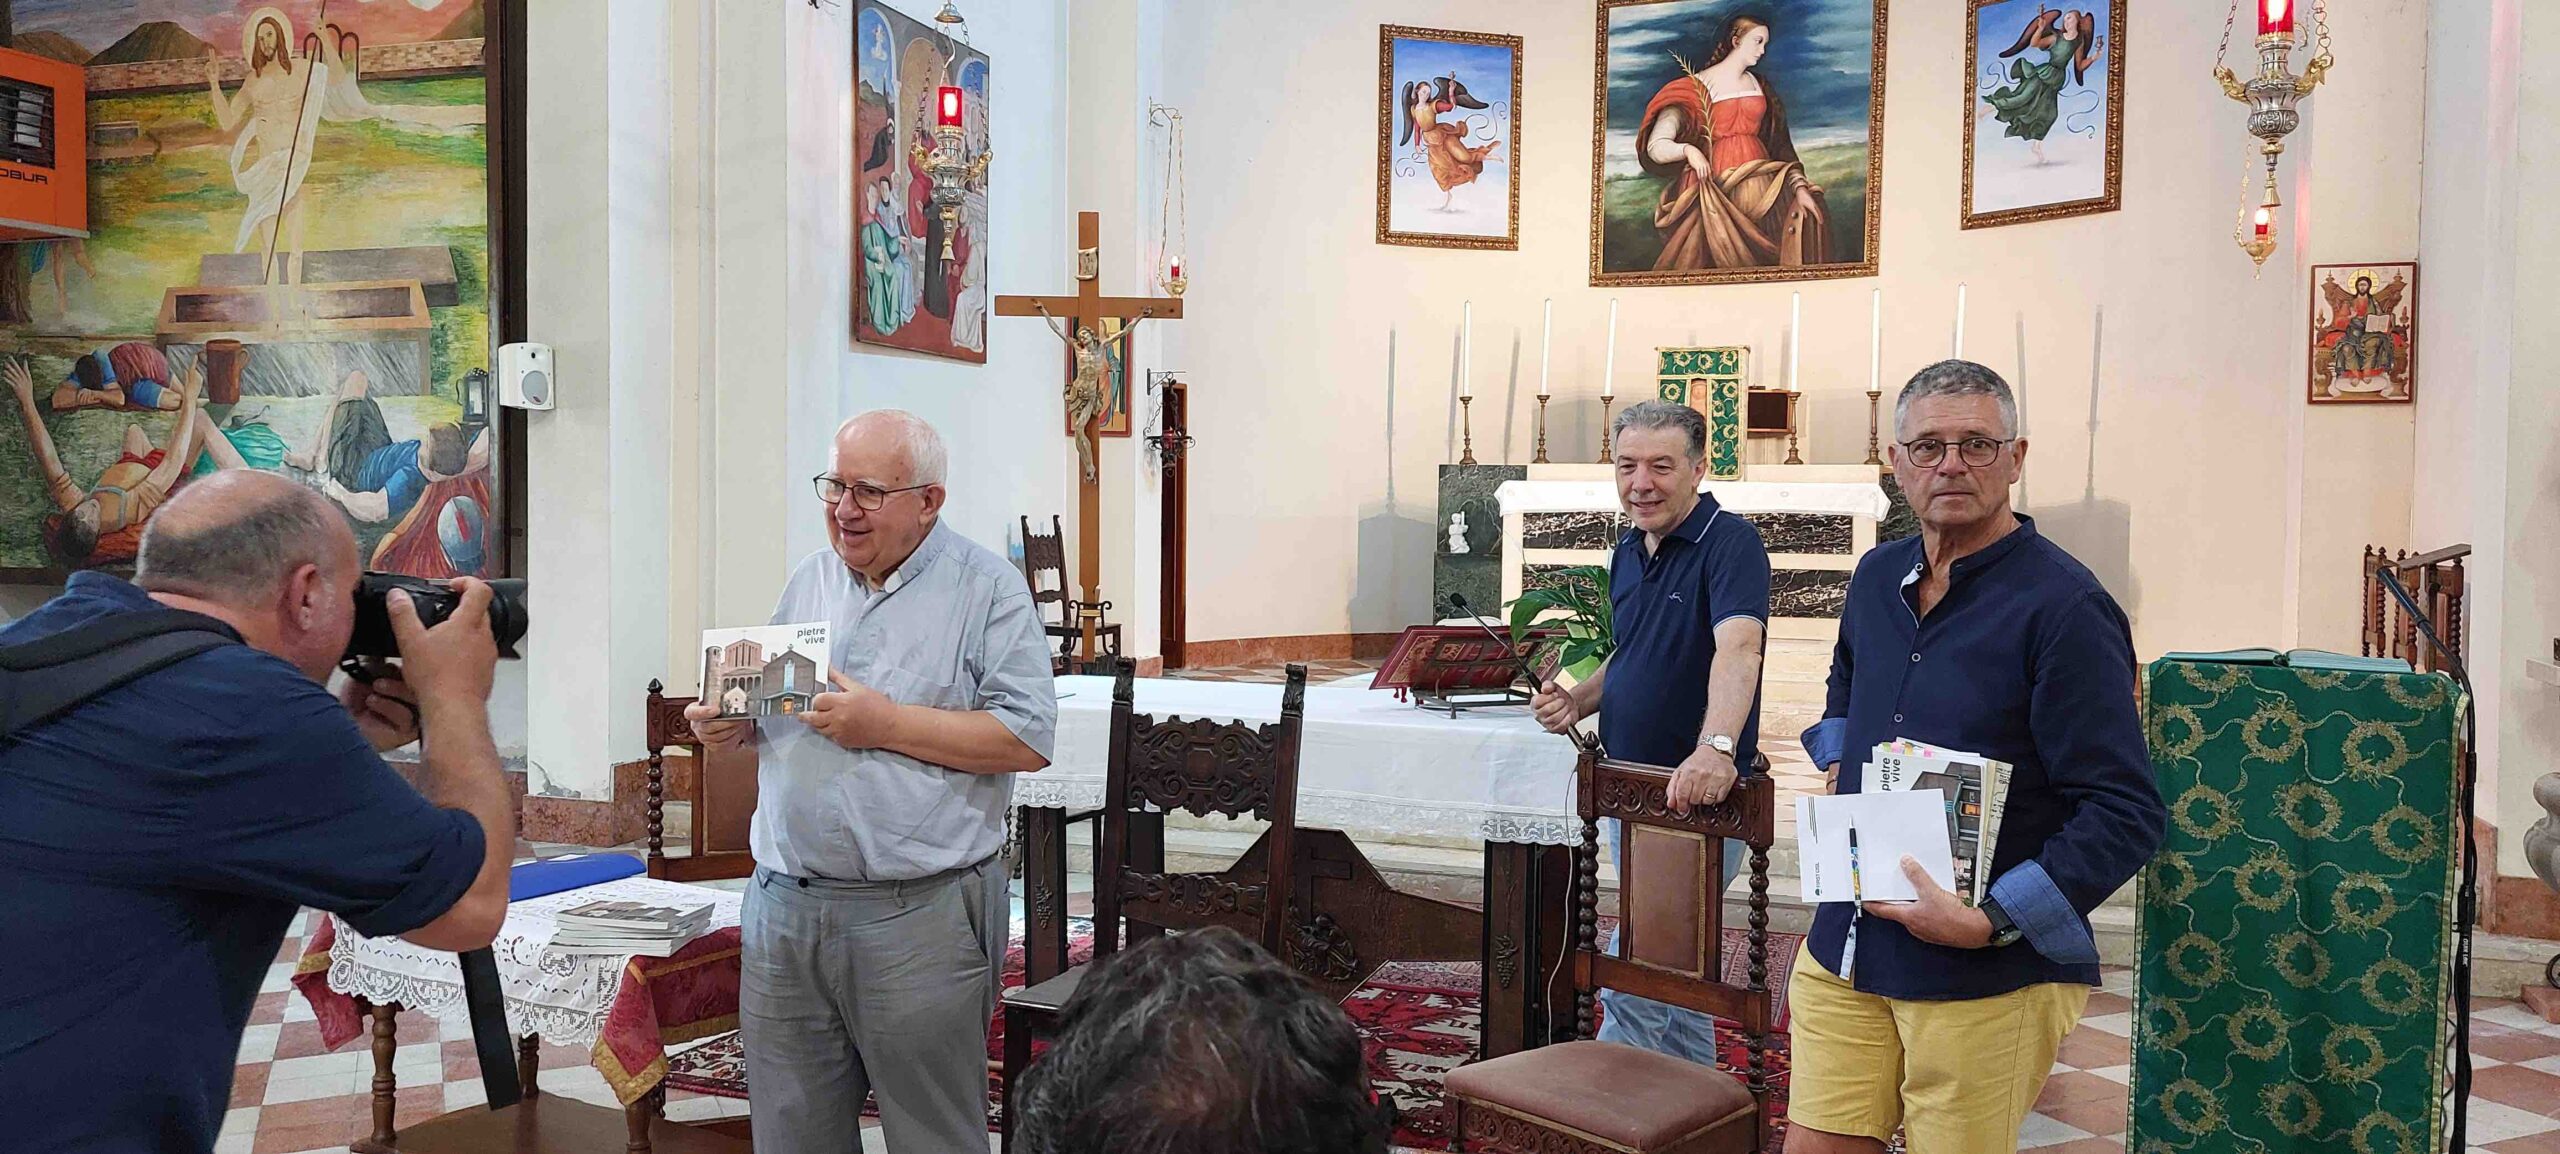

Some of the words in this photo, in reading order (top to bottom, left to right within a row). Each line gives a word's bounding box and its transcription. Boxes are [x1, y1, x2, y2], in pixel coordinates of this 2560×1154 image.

[797, 627, 826, 639] pietre
[804, 636, 825, 644] vive
[1880, 757, 1891, 791] pietre
[1890, 758, 1900, 782] vive
